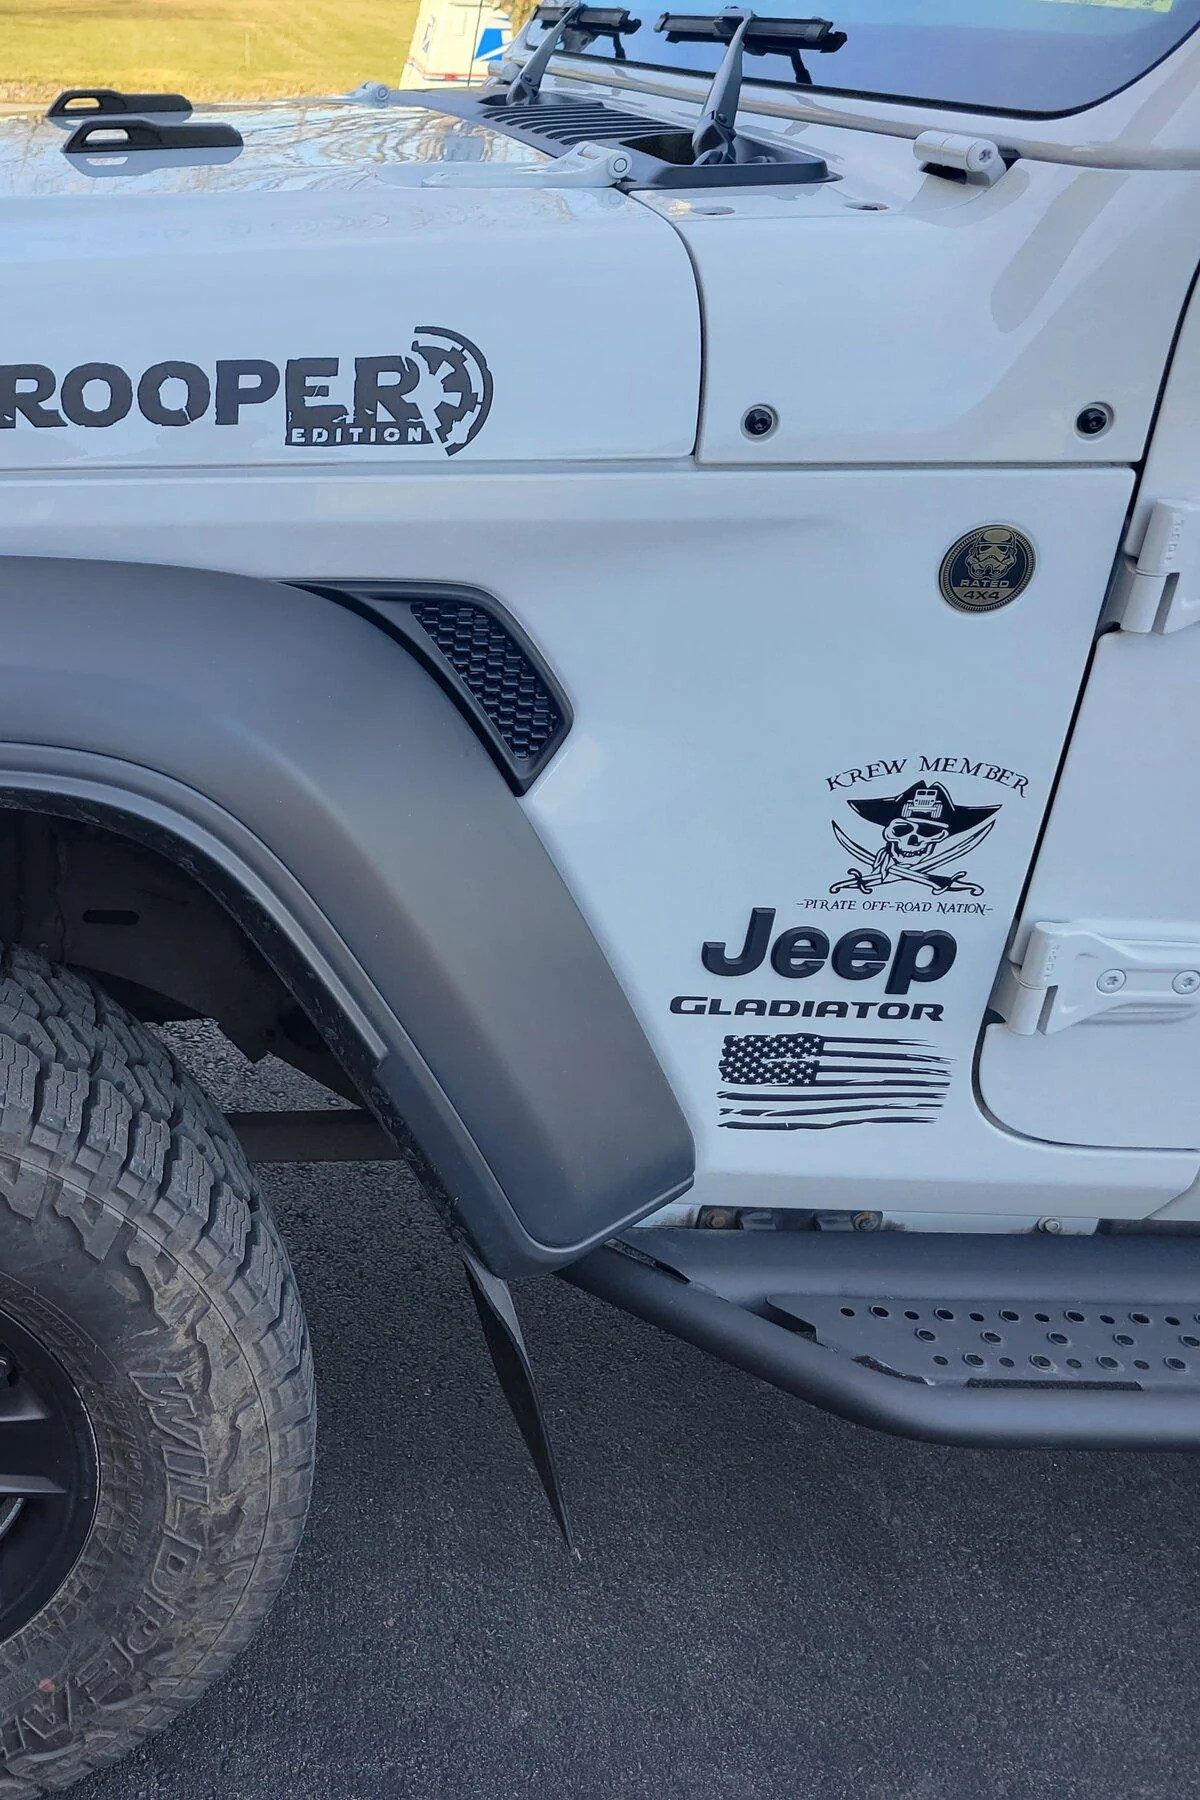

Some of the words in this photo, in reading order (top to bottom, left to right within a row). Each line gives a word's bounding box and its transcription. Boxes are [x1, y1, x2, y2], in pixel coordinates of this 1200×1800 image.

[291, 427, 423, 444] EDITION
[960, 580, 1010, 588] RATED
[824, 758, 907, 792] KREW
[919, 755, 1029, 798] MEMBER
[863, 900, 932, 913] OFF-ROAD
[701, 907, 958, 995] Jeep
[669, 995, 944, 1022] GLADIATOR
